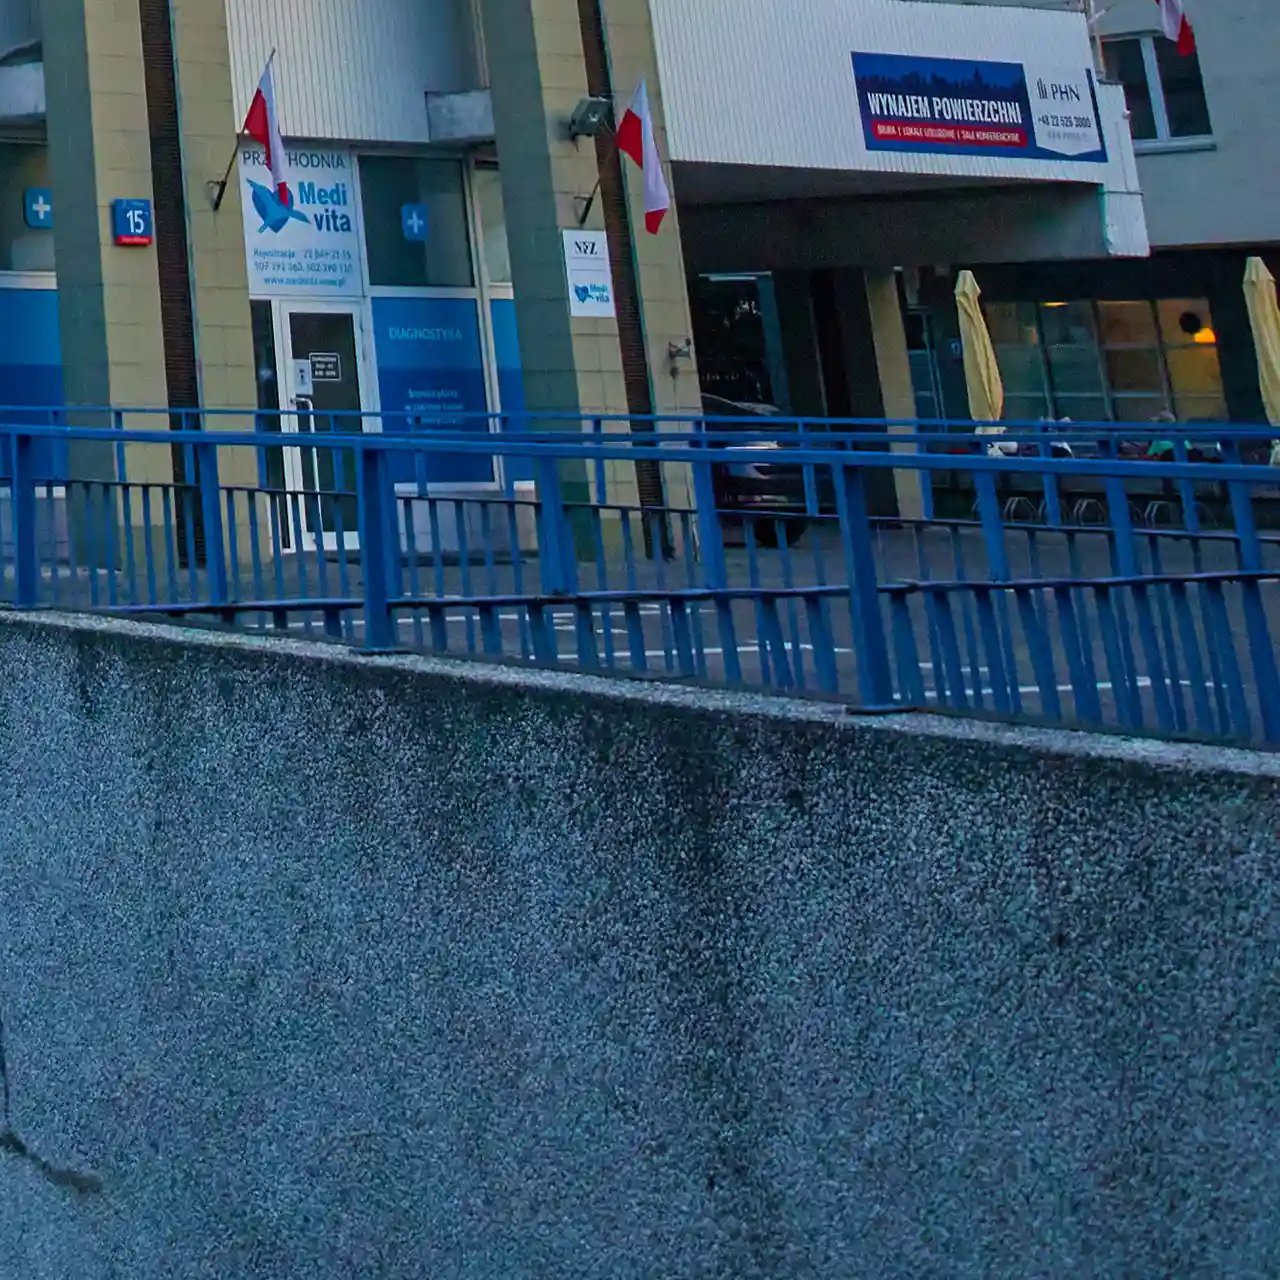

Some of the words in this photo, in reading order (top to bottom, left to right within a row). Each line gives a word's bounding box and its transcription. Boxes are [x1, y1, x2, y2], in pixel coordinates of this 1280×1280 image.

[1051, 83, 1081, 101] PHN
[866, 92, 930, 118] WYNAJEM
[932, 95, 1023, 124] POWIERZCHNI
[1050, 115, 1059, 127] 22
[242, 150, 346, 168] PRZHODNIA
[298, 181, 348, 206] Medi
[126, 209, 145, 234] 15
[313, 208, 352, 232] vita
[574, 240, 598, 255] NFZ
[388, 326, 463, 340] DIAGNOSTYKA
